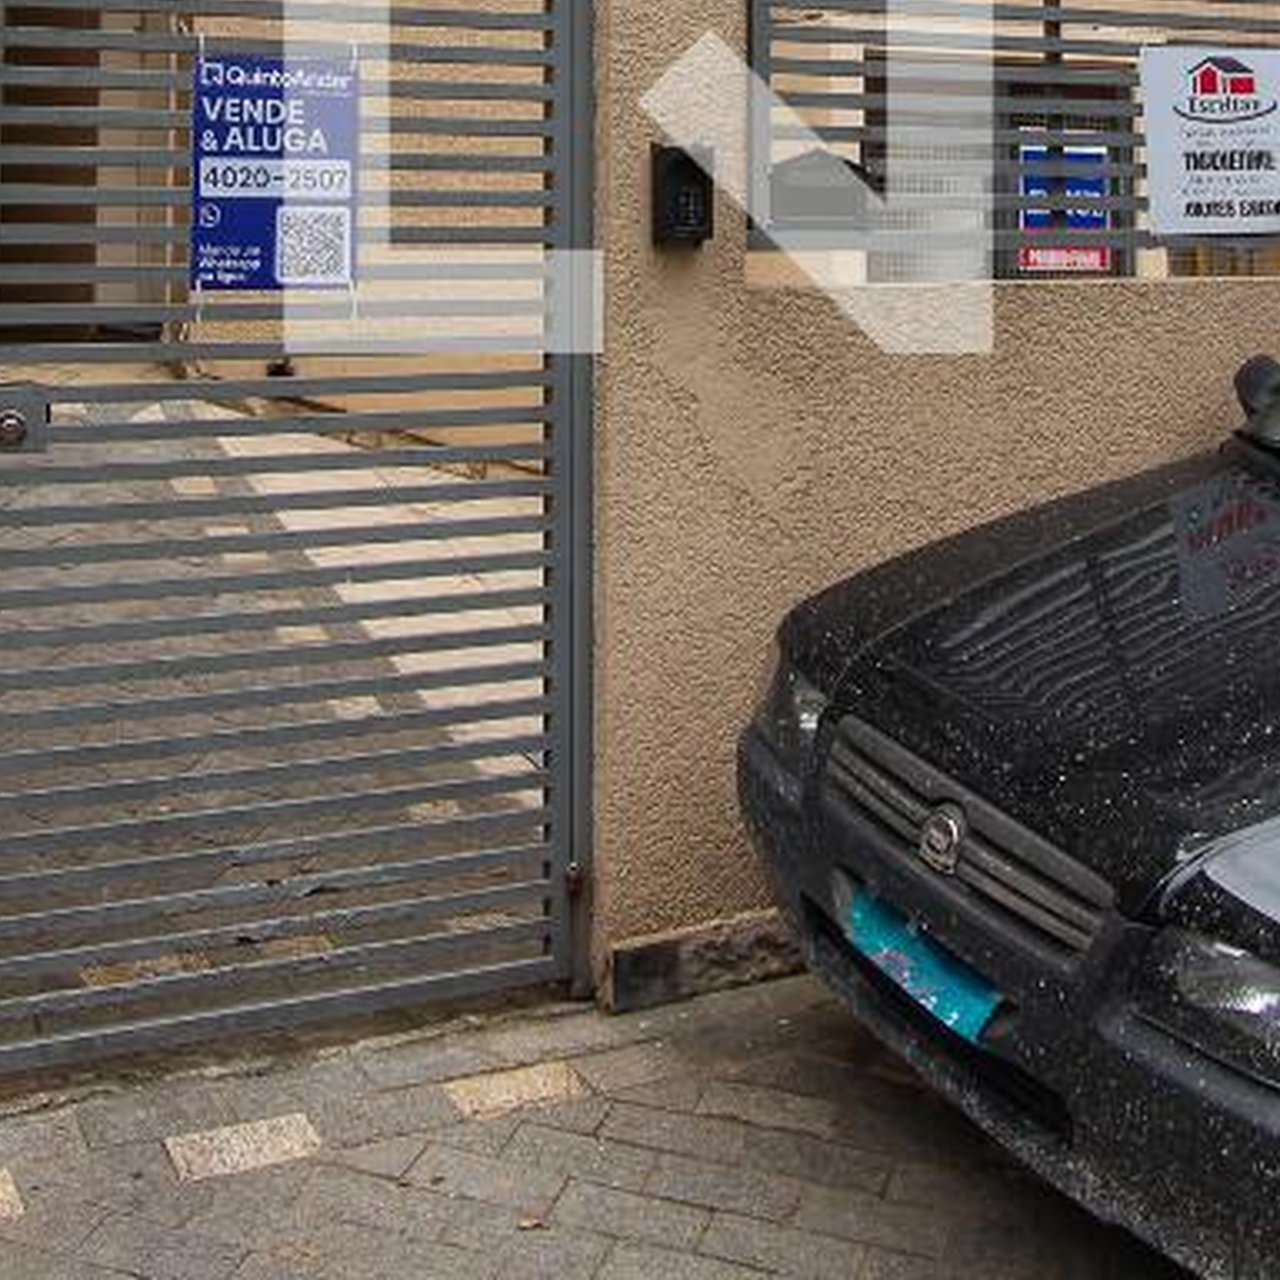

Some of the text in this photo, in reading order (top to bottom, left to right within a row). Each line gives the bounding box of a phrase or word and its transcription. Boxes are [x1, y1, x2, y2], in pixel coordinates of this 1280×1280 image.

[202, 97, 304, 124] VENDE
[199, 127, 328, 152] & ALUGA
